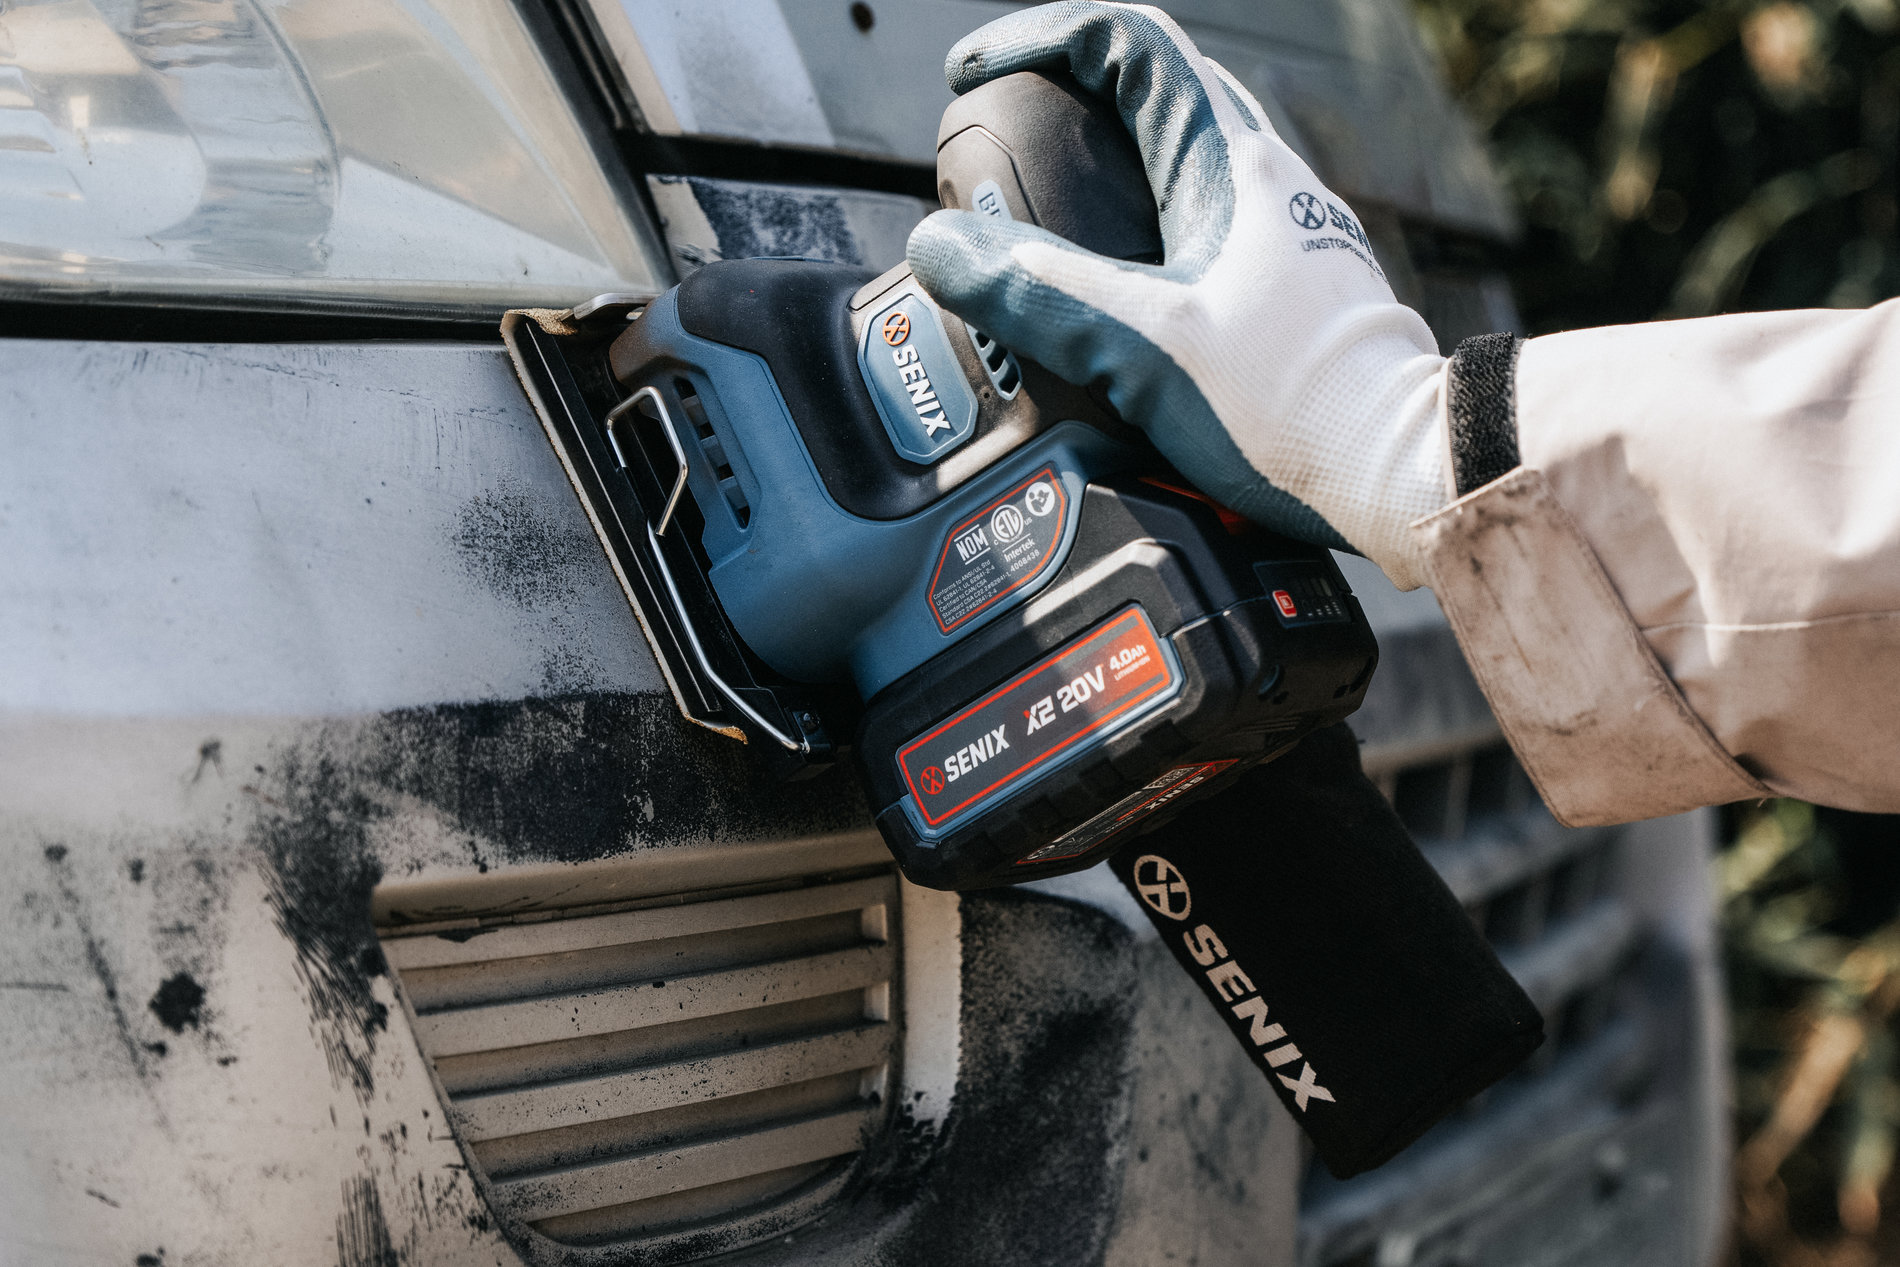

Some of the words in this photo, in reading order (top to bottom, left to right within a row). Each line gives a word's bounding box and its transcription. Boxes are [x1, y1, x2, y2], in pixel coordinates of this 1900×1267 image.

[892, 344, 951, 438] SENIX
[956, 528, 989, 561] NOM
[1004, 538, 1035, 562] Intertek
[1010, 550, 1040, 572] 4008438
[932, 582, 956, 600] Conforms
[938, 596, 960, 612] Certified
[941, 601, 964, 618] Standard
[1110, 645, 1146, 670] 4.0Ah
[944, 724, 1010, 782] SENIX
[1023, 696, 1056, 736] X2
[1056, 664, 1106, 713] 20V
[1145, 776, 1204, 810] SENIX
[1183, 924, 1336, 1112] SENIX
